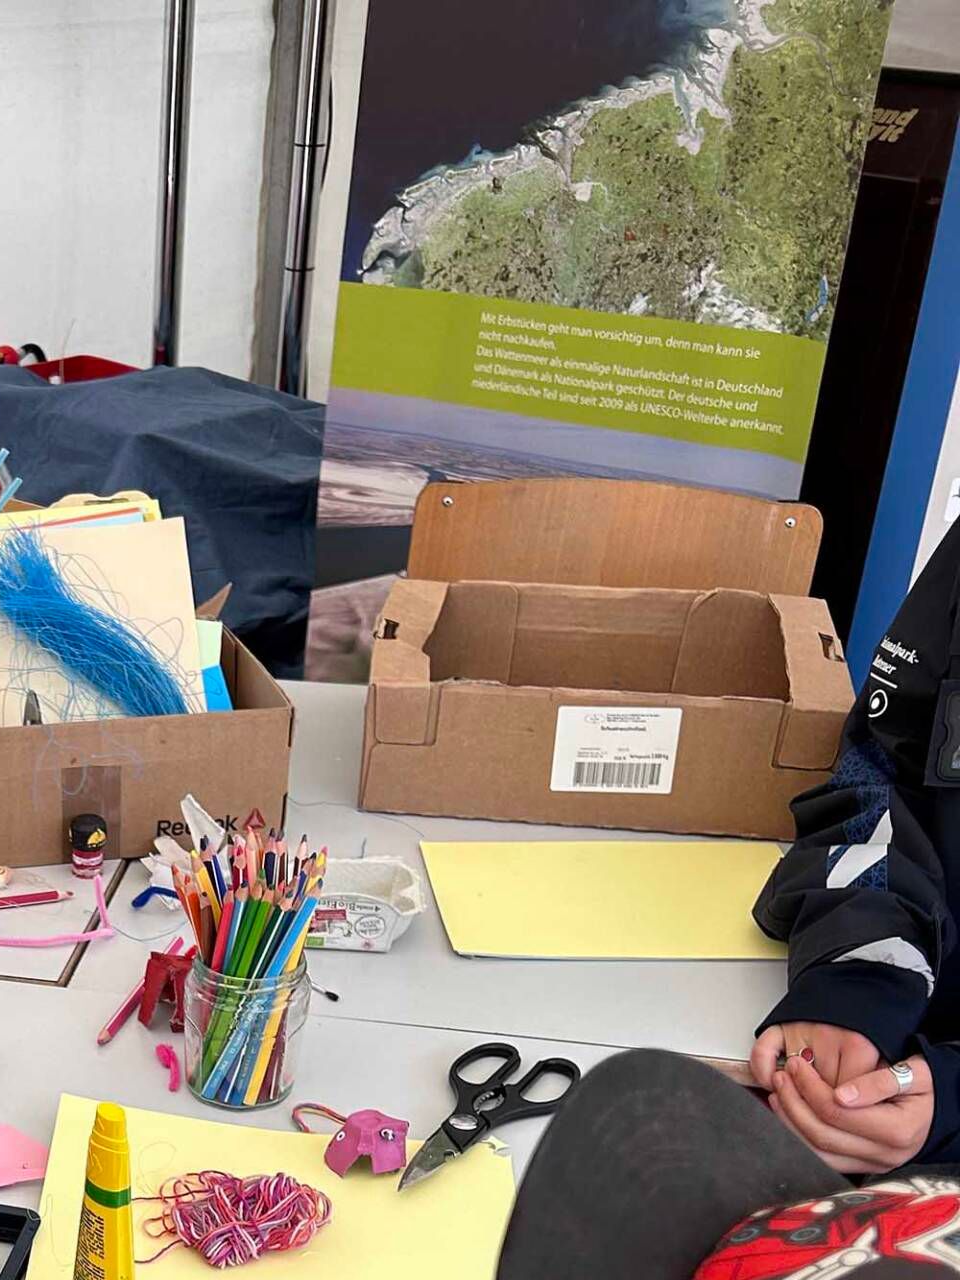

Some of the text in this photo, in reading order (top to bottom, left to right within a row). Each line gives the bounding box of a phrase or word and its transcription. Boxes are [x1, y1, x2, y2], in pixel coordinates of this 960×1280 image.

[479, 331, 501, 341] nicht
[481, 311, 496, 324] Mit
[498, 314, 546, 331] Erbstücken
[548, 322, 569, 336] geht
[571, 325, 592, 337] man
[594, 329, 642, 346] vorsichtig
[665, 335, 691, 350] denn
[692, 341, 714, 353] man
[716, 343, 743, 357] kann
[745, 347, 761, 359] sie
[473, 363, 492, 374] und
[494, 365, 538, 380] Dänemark
[541, 372, 552, 384] als
[554, 373, 613, 391] Nationalpark
[668, 389, 685, 402] Der
[687, 393, 733, 410] deutsche
[735, 400, 758, 412] und
[476, 344, 784, 398] Das Wattenmeer als einmalige Naturlandschaft ist in Deutschland
[471, 377, 541, 397] niederländische
[543, 387, 557, 400] Teil
[559, 391, 579, 404] sind
[580, 395, 597, 407] seit
[599, 396, 623, 410] 2009
[625, 401, 638, 413] als
[640, 402, 728, 426] UNESCO-Welterbe
